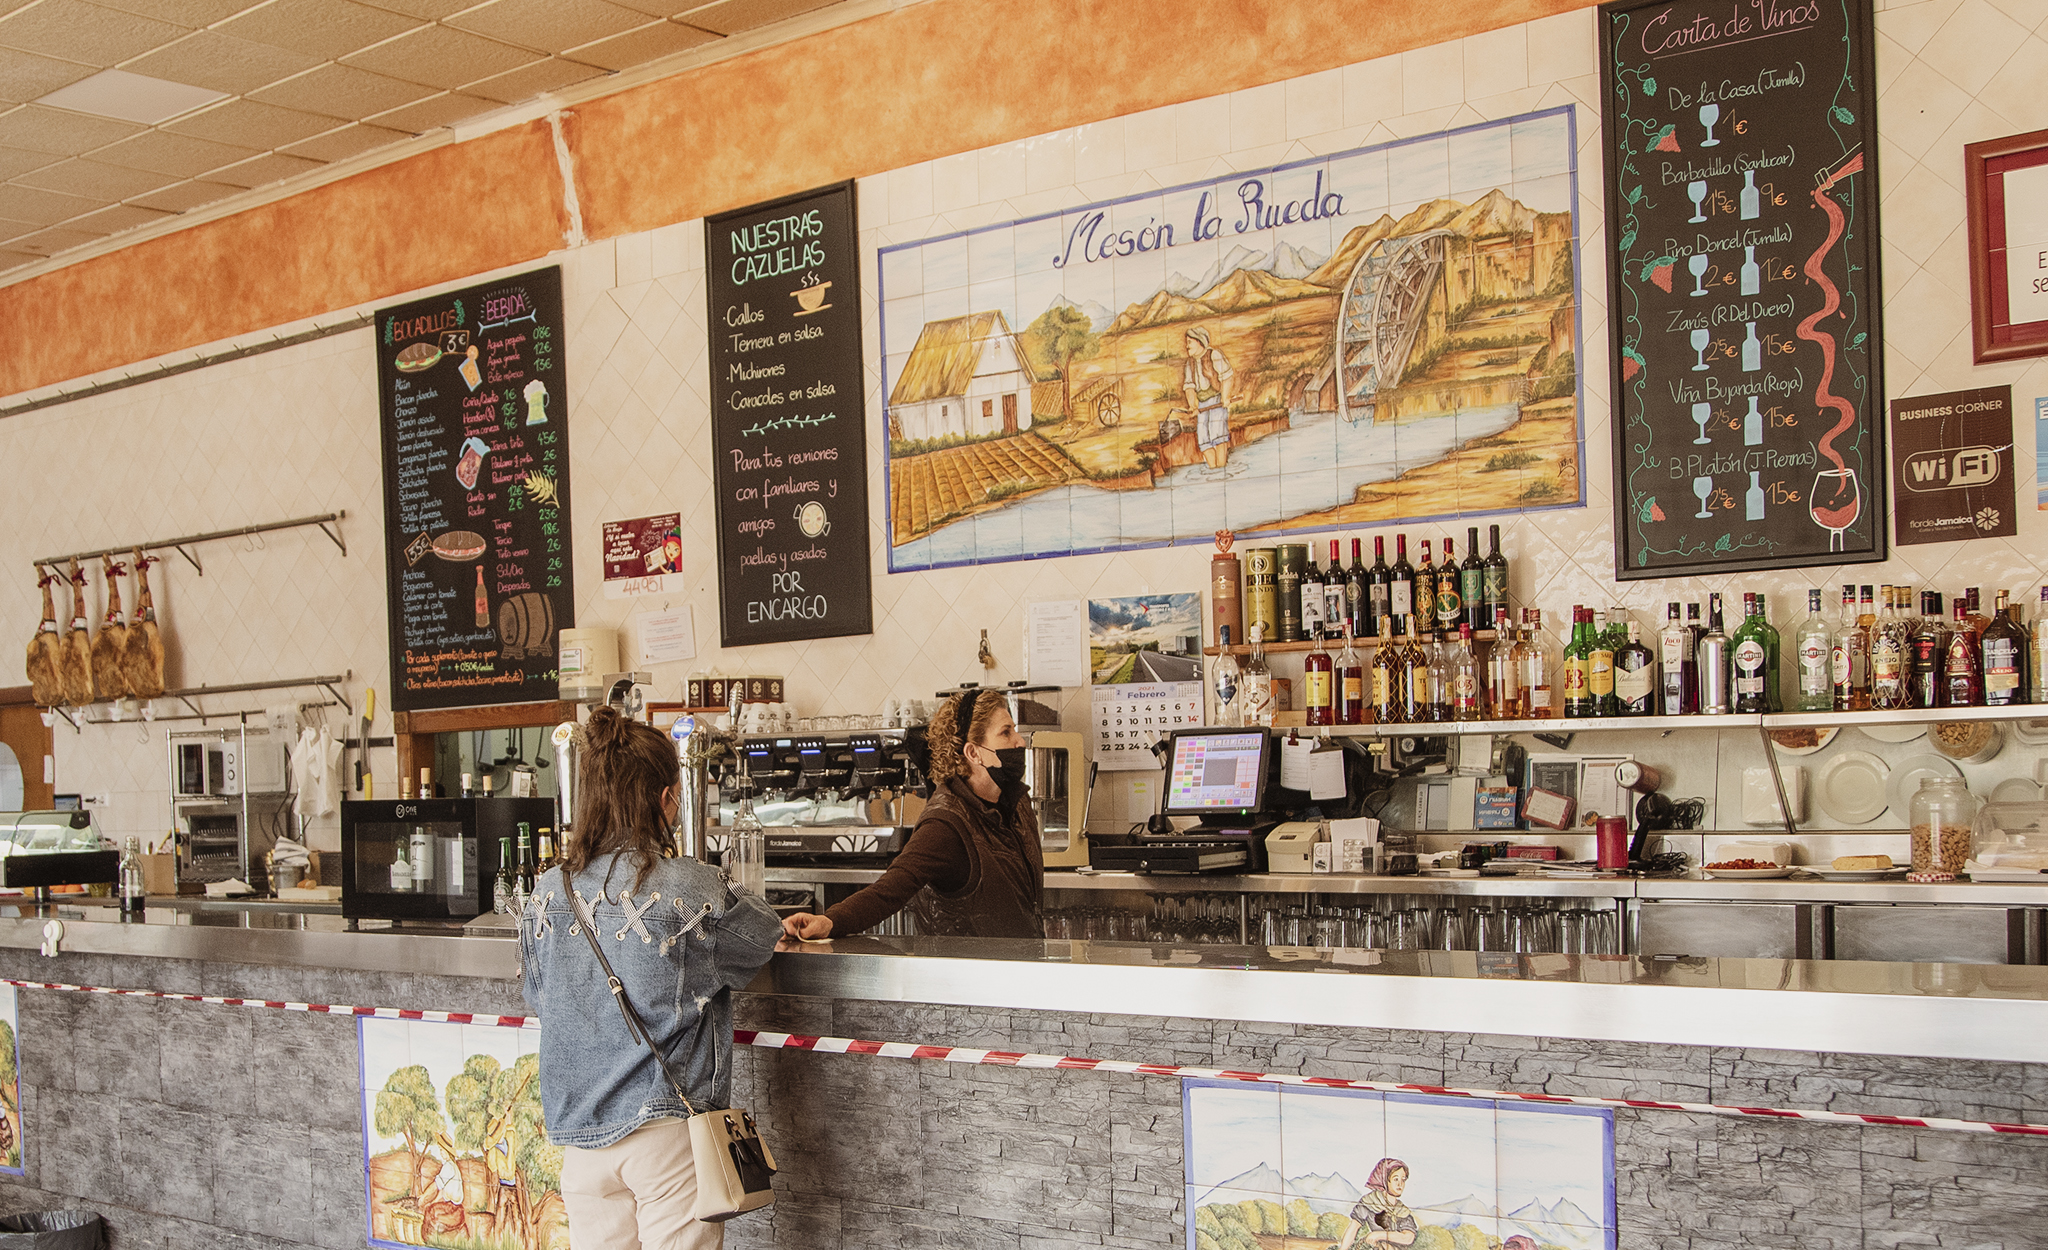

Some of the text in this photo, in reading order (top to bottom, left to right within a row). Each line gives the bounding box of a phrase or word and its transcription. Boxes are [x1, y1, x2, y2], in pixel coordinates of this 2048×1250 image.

[1642, 0, 1820, 54] Carta de Vinos
[1668, 62, 1805, 110] De la Casa (Jumilla)
[1722, 108, 1748, 136] 1€
[1661, 144, 1795, 186] Barbadillo (Sanlucar)
[1761, 183, 1788, 206] 9€
[1053, 169, 1349, 269] Mesón la Rueda
[731, 210, 823, 254] NUESTRAS
[1664, 223, 1792, 258] Pino Doncel (Jumilla)
[732, 240, 825, 285] CAZUELAS
[1705, 257, 1796, 288] 2€ 12€
[727, 302, 764, 327] Callos
[1752, 294, 1794, 318] Duero)
[394, 309, 456, 342] BOCADILLOS
[446, 334, 466, 352] 3€
[487, 339, 503, 356] Agua
[729, 324, 824, 352] Ternera en salsa
[1761, 334, 1796, 356] 15€
[487, 356, 502, 371] Agua
[730, 362, 786, 383] Michirones
[504, 388, 516, 400] 1€
[731, 380, 836, 410] Caracoles en salsa
[1669, 367, 1804, 405] Viña Bujanda (Rioja)
[1764, 406, 1798, 428] 15€
[1900, 400, 2002, 421] BUSINESS CORNER
[543, 449, 557, 460] 2€
[730, 446, 838, 472] Para tus reuniones
[508, 497, 524, 511] 2€
[736, 476, 837, 508] con familiares y
[1766, 481, 1801, 504] 15€
[738, 517, 776, 538] amigos
[547, 538, 561, 552] 2€
[547, 557, 562, 570] 2€
[740, 543, 827, 575] paellas y asados
[546, 575, 562, 586] 2€
[773, 571, 804, 594] POR
[747, 594, 828, 623] ENCARGO
[1455, 680, 1472, 691] 103
